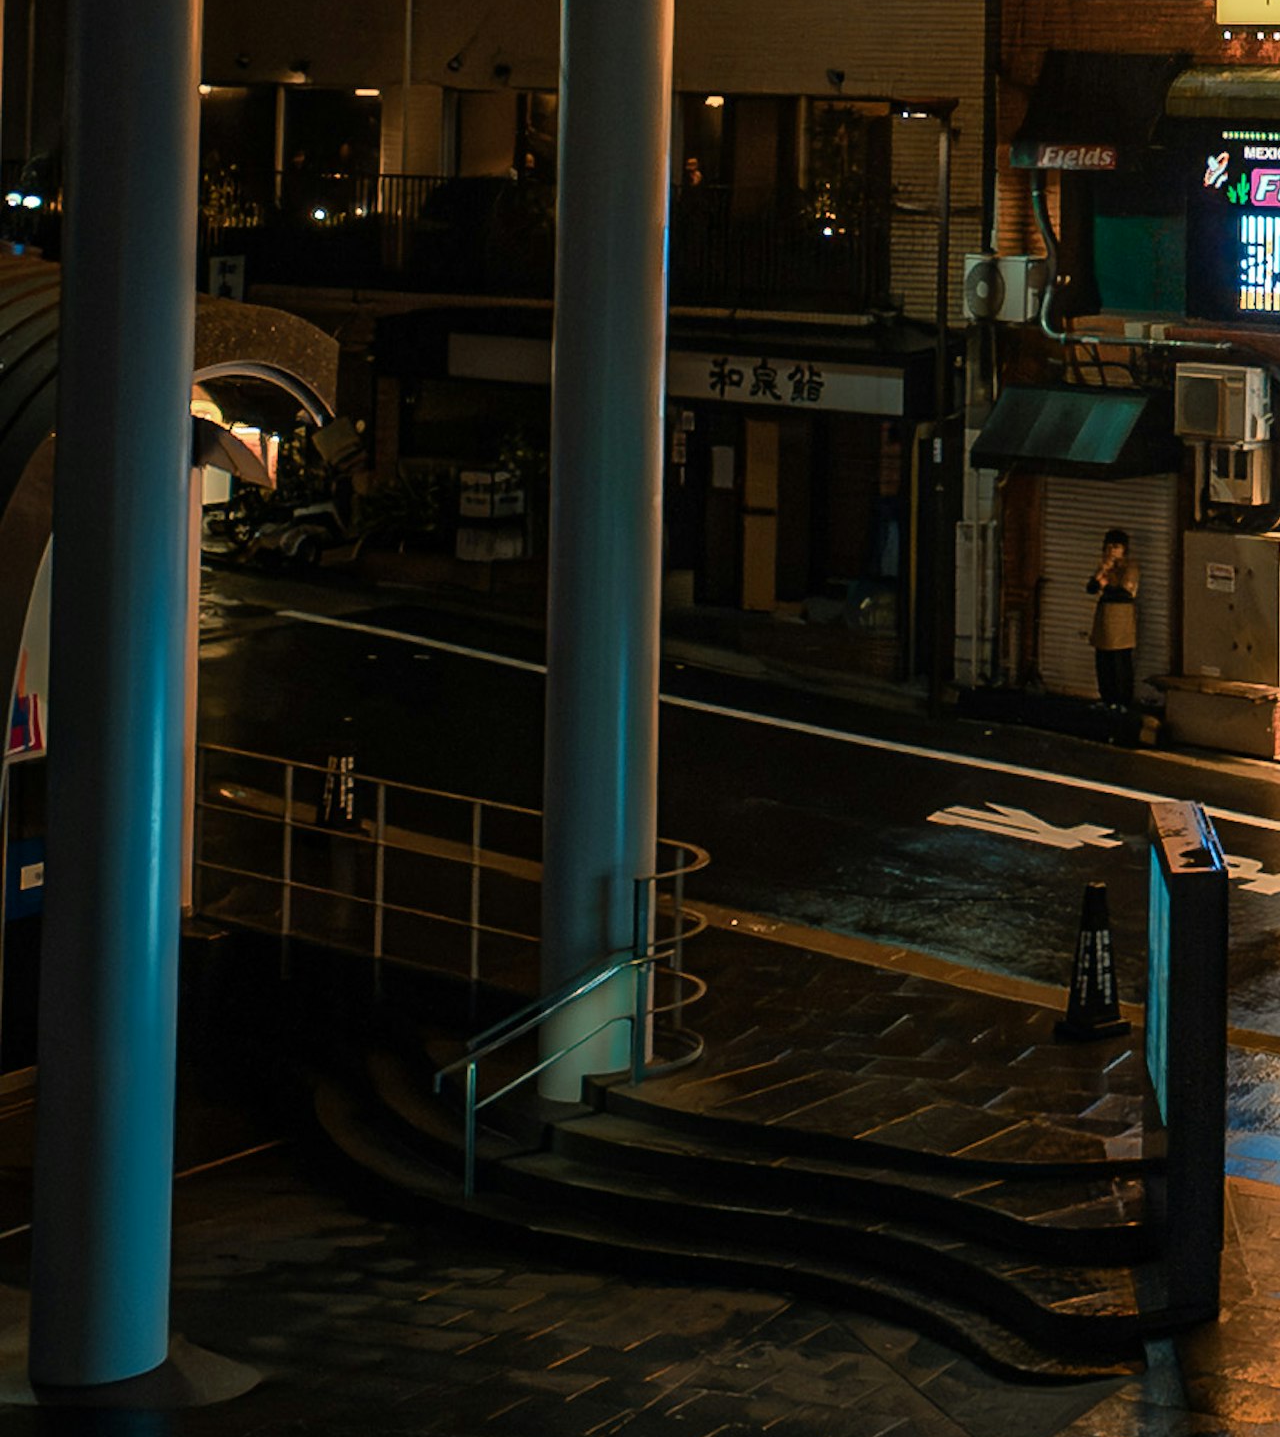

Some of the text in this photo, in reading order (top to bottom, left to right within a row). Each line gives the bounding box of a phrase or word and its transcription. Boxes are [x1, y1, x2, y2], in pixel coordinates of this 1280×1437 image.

[1041, 146, 1113, 167] Fields
[708, 356, 825, 403] 和泉鮨
